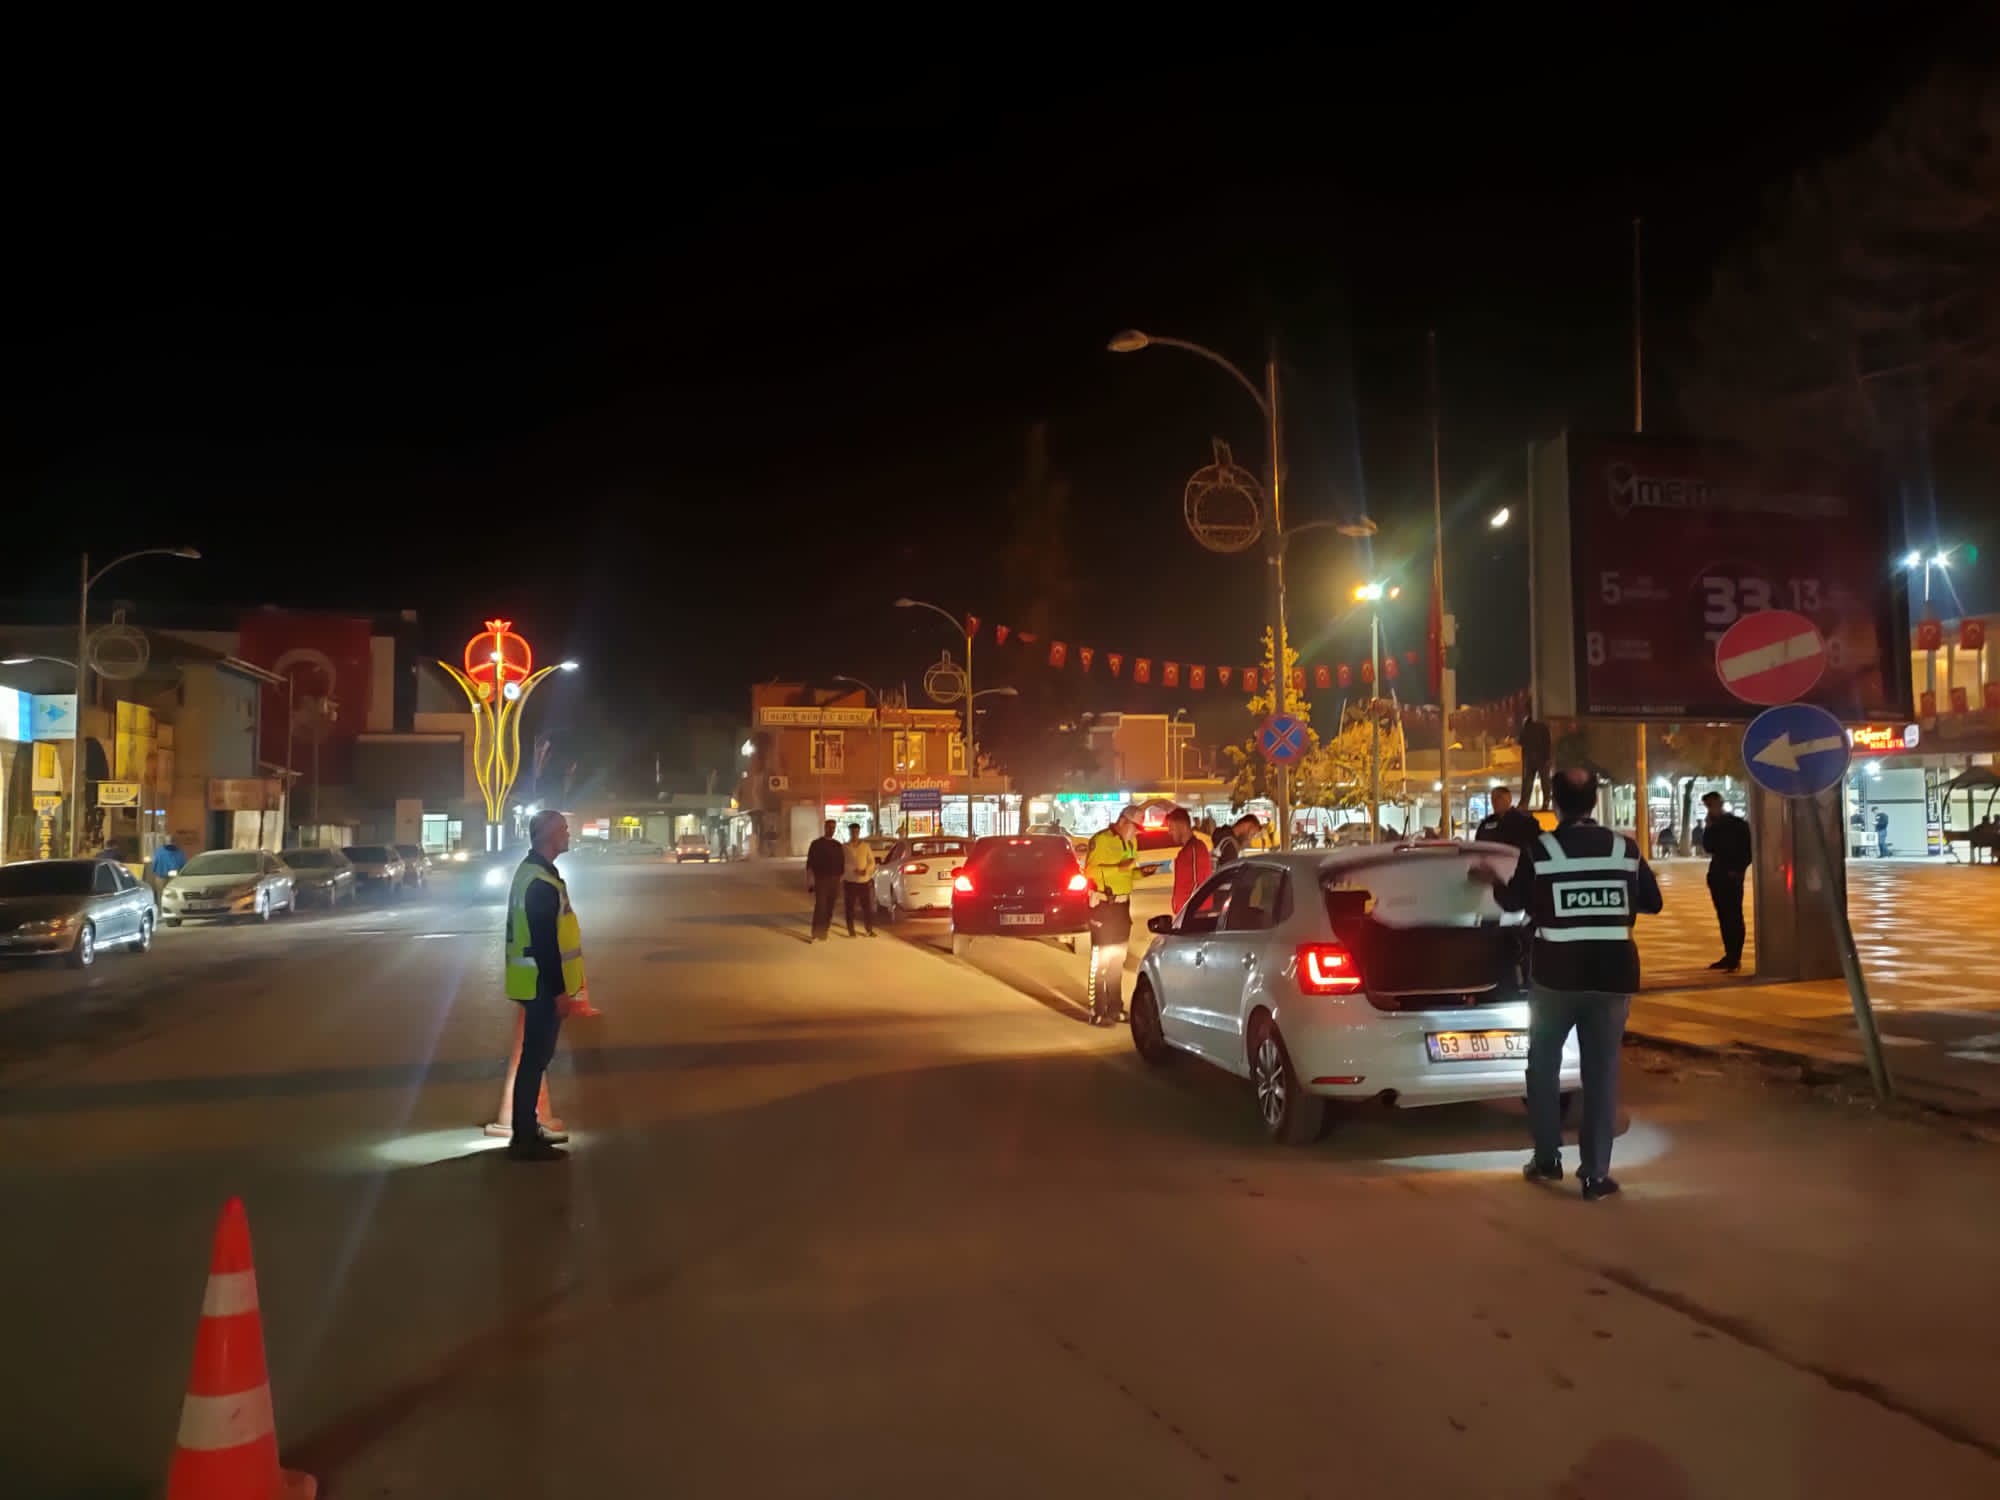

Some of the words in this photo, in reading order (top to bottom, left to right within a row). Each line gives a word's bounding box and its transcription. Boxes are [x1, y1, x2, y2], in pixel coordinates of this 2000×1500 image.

[1599, 571, 1622, 605] 5
[899, 777, 951, 790] vodafone
[1567, 888, 1622, 907] POLİS
[1439, 1035, 1460, 1053] 63
[1469, 1034, 1490, 1052] BD
